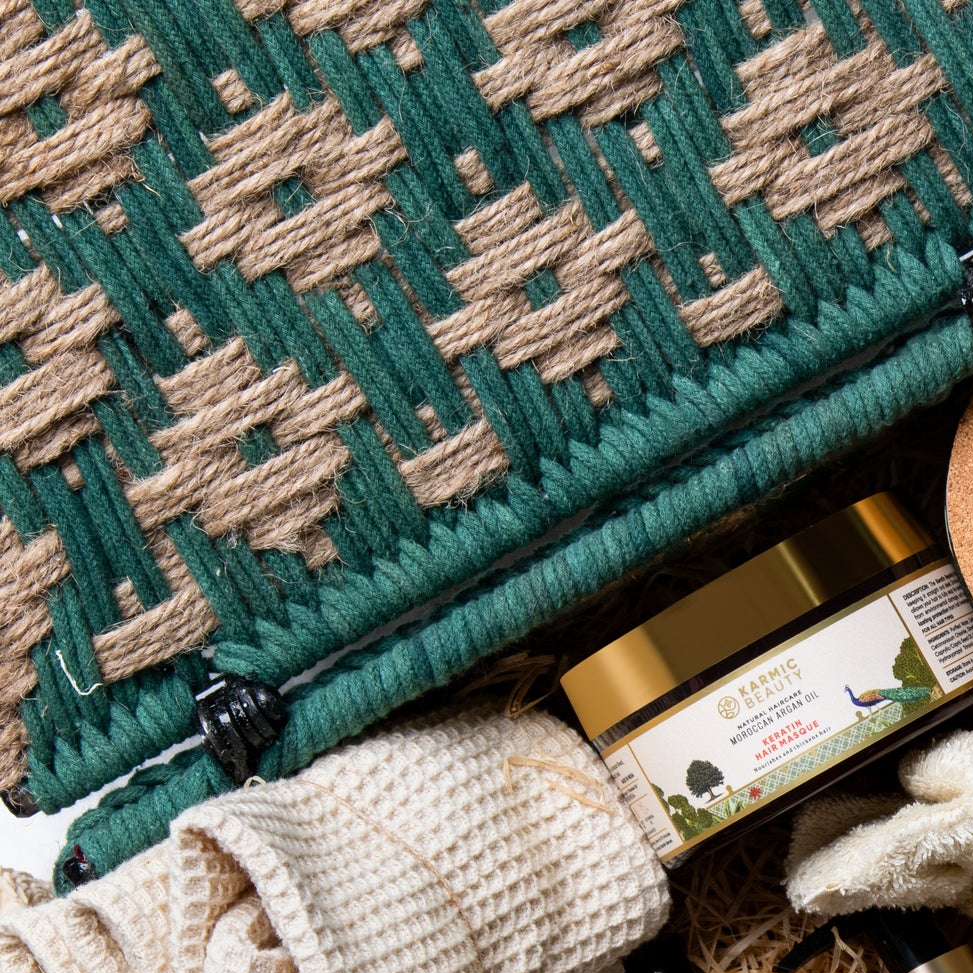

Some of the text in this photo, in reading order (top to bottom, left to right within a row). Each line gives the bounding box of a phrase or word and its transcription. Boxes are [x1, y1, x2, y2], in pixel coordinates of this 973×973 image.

[921, 626, 930, 634] FOR
[936, 618, 945, 626] HAIR
[943, 613, 954, 621] TYPES
[738, 658, 797, 698] KARMIC
[743, 668, 802, 709] BEAUTY
[729, 690, 819, 746] MOROCCAN ARGAN OIL
[736, 689, 802, 730] NATURAL HAIRCARE
[753, 726, 831, 773] Nourishes and thickens hair
[754, 719, 819, 761] HAIR MASQUE
[761, 719, 802, 746] KERATIN
